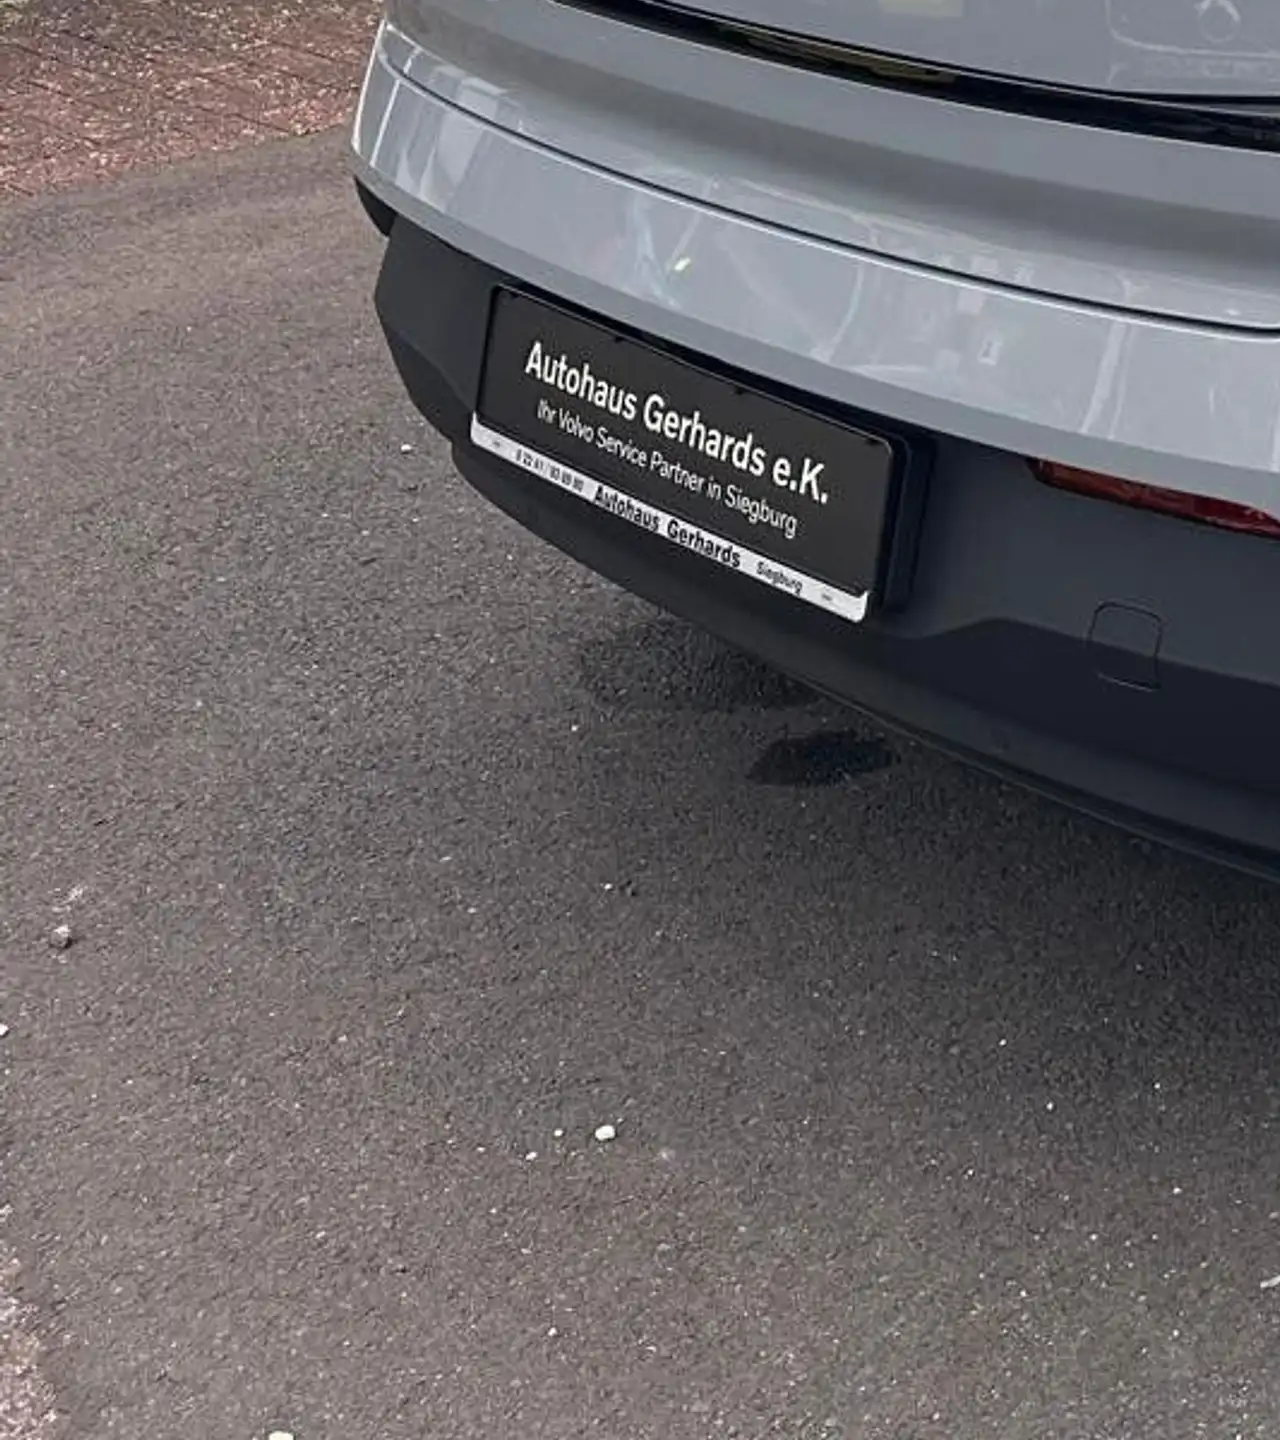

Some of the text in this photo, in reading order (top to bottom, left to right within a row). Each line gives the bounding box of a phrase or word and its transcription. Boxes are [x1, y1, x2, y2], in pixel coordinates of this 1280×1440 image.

[525, 340, 829, 504] Autohaus Gerhards e.K.
[536, 399, 799, 539] Ihr Volvo Service Partner in Siegburg
[594, 485, 661, 532] Autohaus
[666, 518, 742, 570] Gerhards
[756, 560, 803, 596] Siegburg
